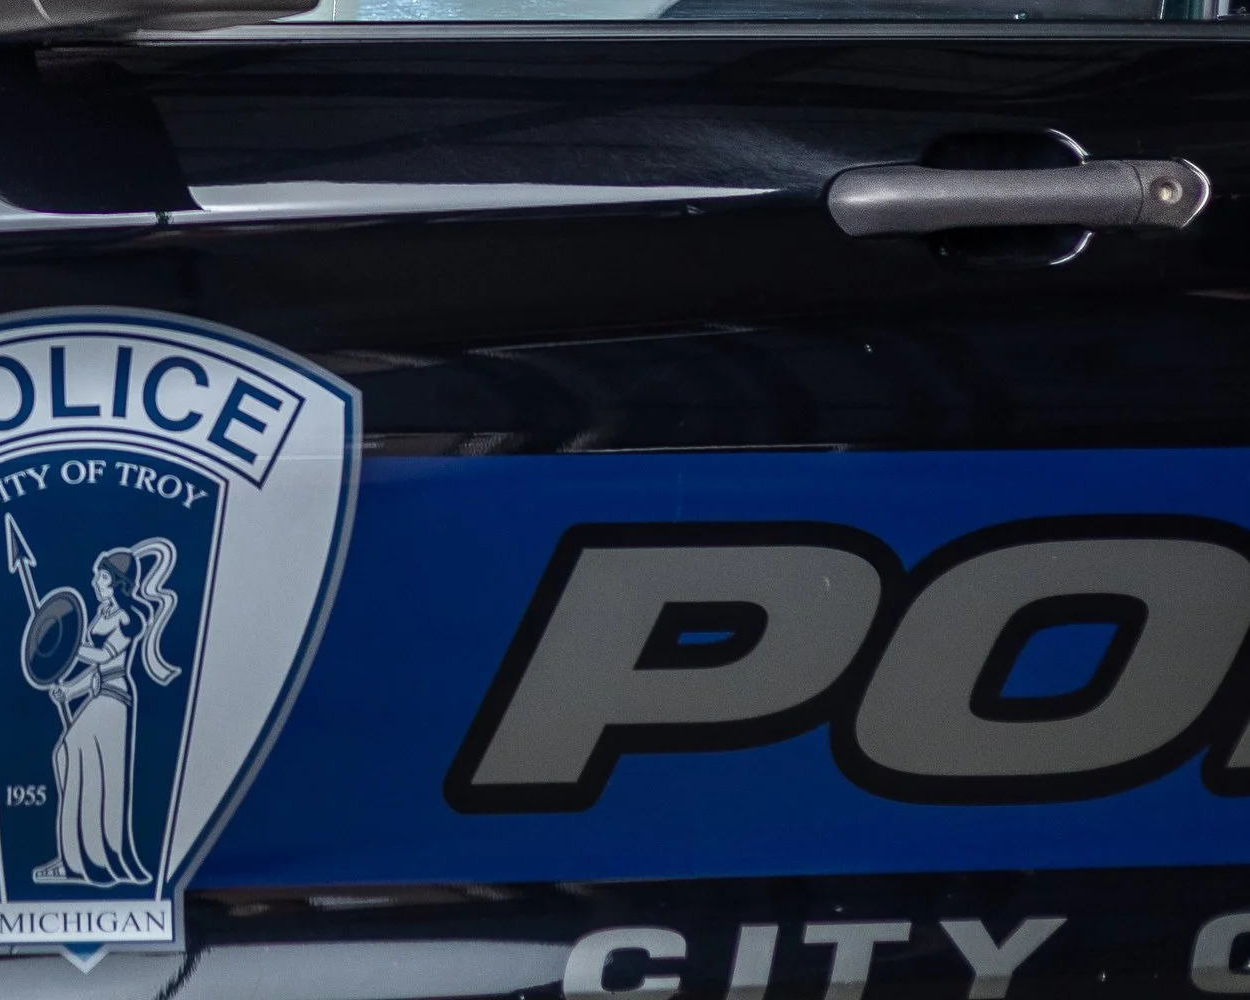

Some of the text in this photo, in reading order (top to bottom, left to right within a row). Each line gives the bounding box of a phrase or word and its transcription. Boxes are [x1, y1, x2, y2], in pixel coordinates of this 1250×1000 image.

[60, 459, 106, 485] OF
[115, 461, 208, 509] TROY
[455, 525, 1250, 800] PO
[6, 784, 47, 806] 1955
[0, 911, 166, 934] MICHIGAN
[563, 917, 1067, 1000] CITY
